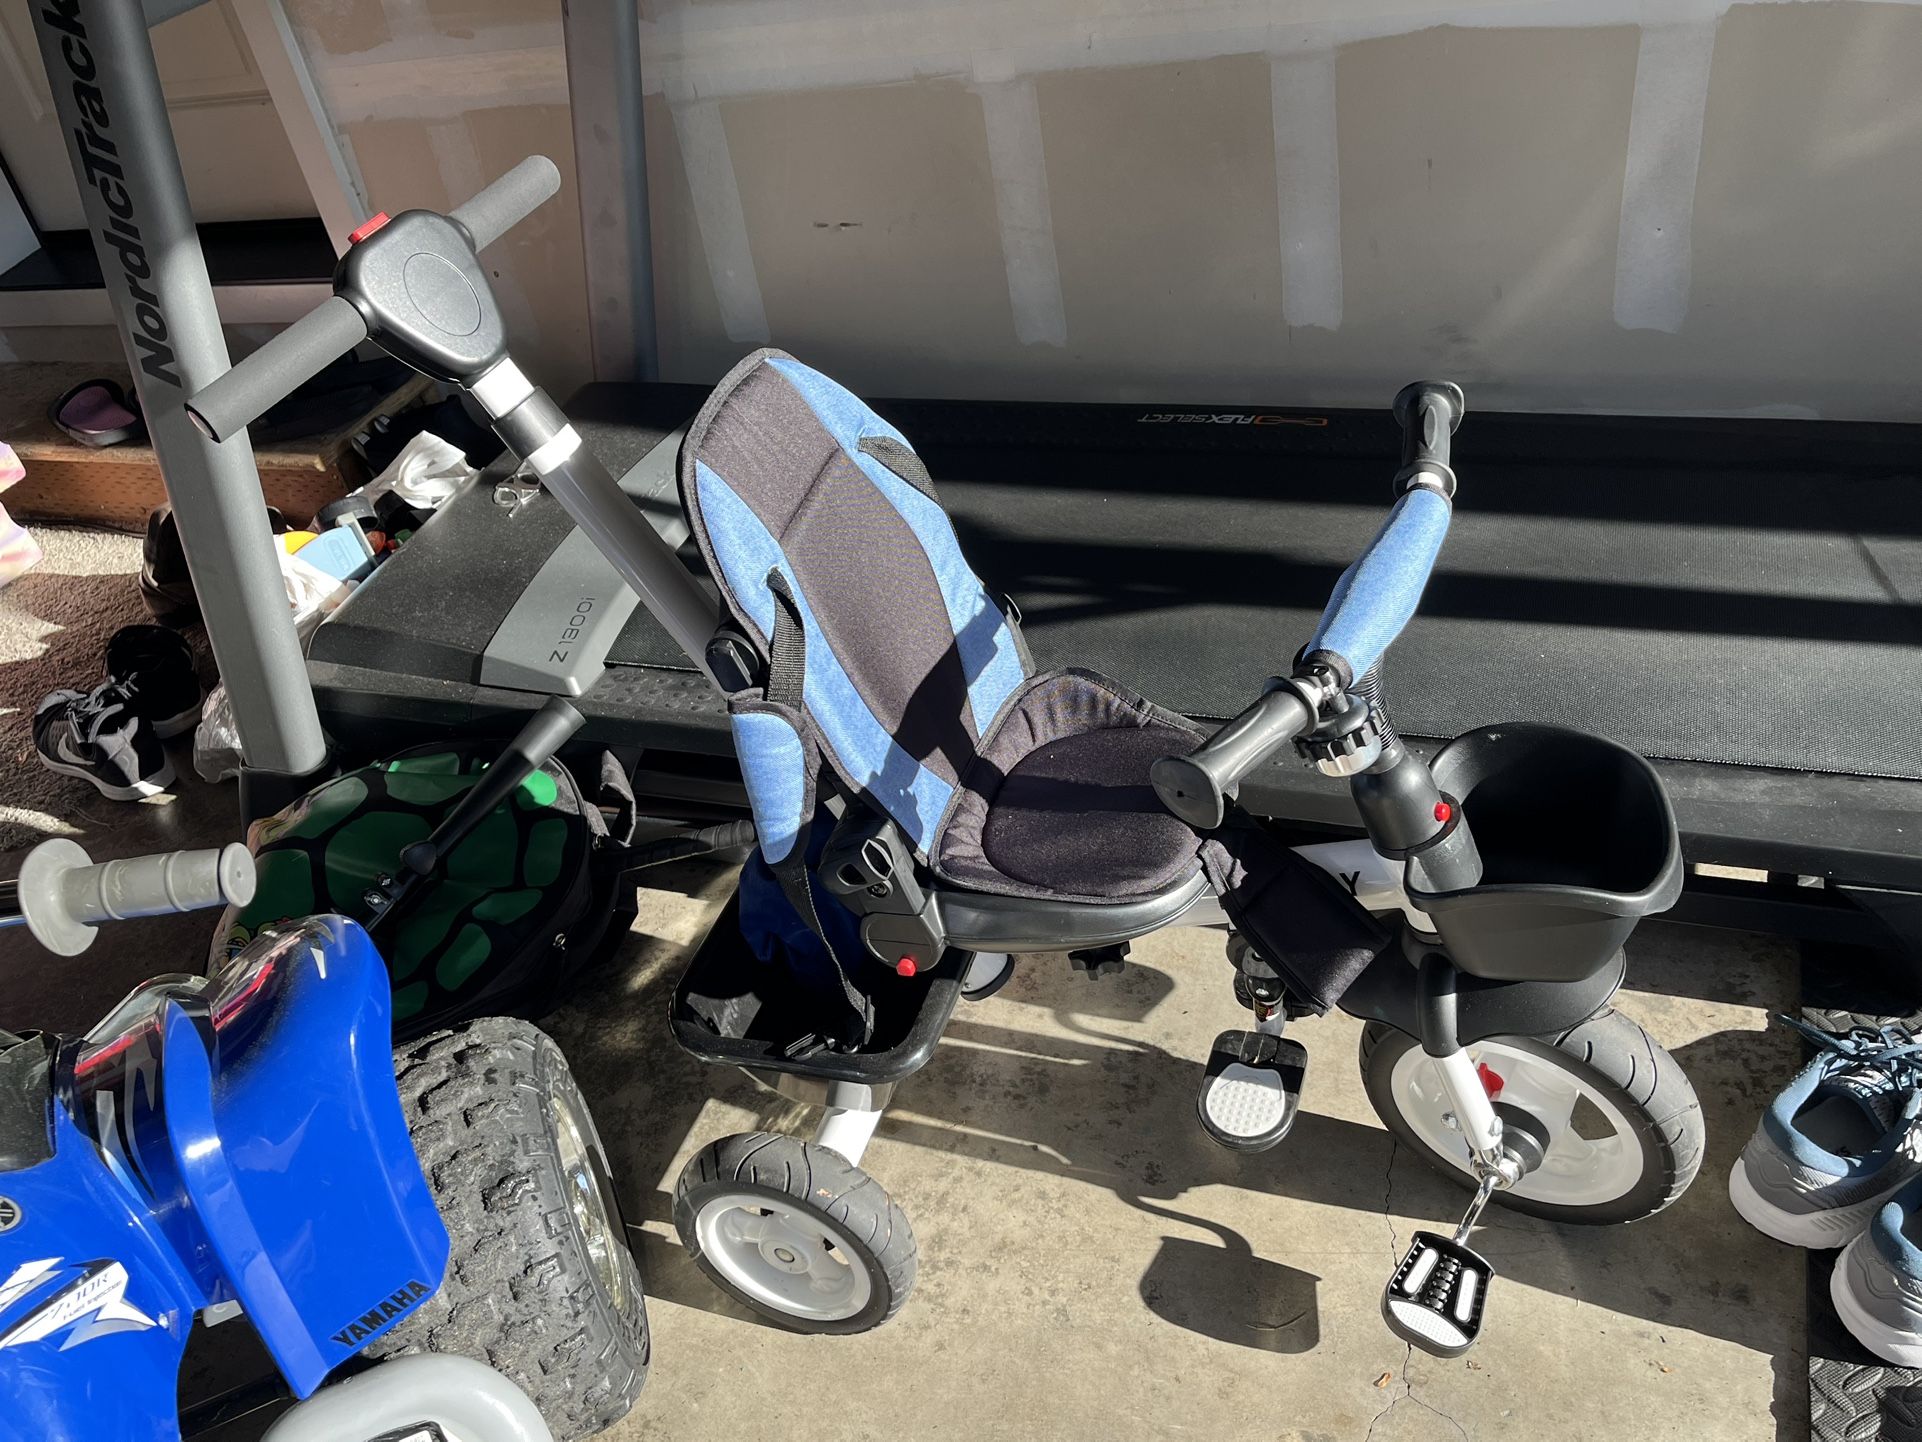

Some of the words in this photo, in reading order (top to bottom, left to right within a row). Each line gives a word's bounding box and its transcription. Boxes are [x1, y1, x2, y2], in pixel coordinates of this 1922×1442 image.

[41, 0, 183, 388] NordicTrack
[548, 649, 569, 663] Z
[330, 1280, 432, 1347] YAMAHA
